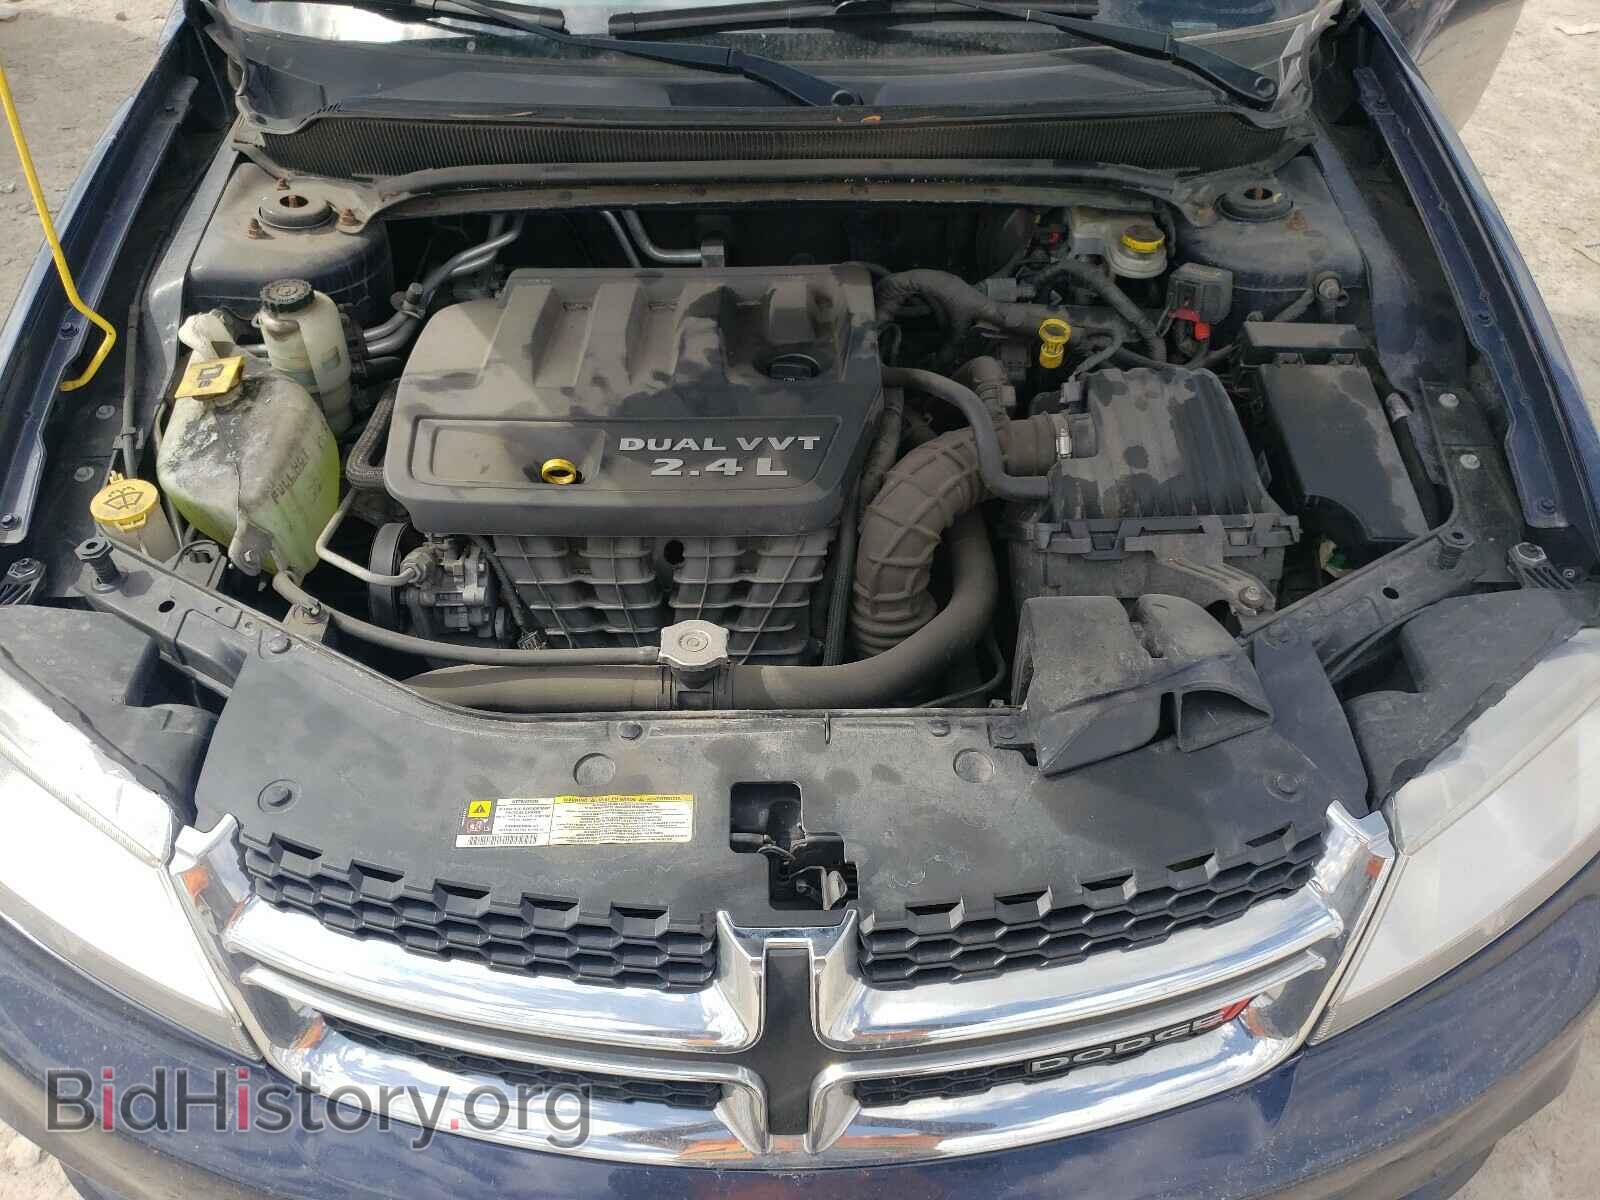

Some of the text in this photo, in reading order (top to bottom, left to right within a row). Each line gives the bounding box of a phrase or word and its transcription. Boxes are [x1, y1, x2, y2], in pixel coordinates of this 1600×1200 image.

[619, 436, 821, 451] DUAL VVT
[651, 456, 788, 476] 2.4 L
[1030, 1012, 1224, 1073] DODGE
